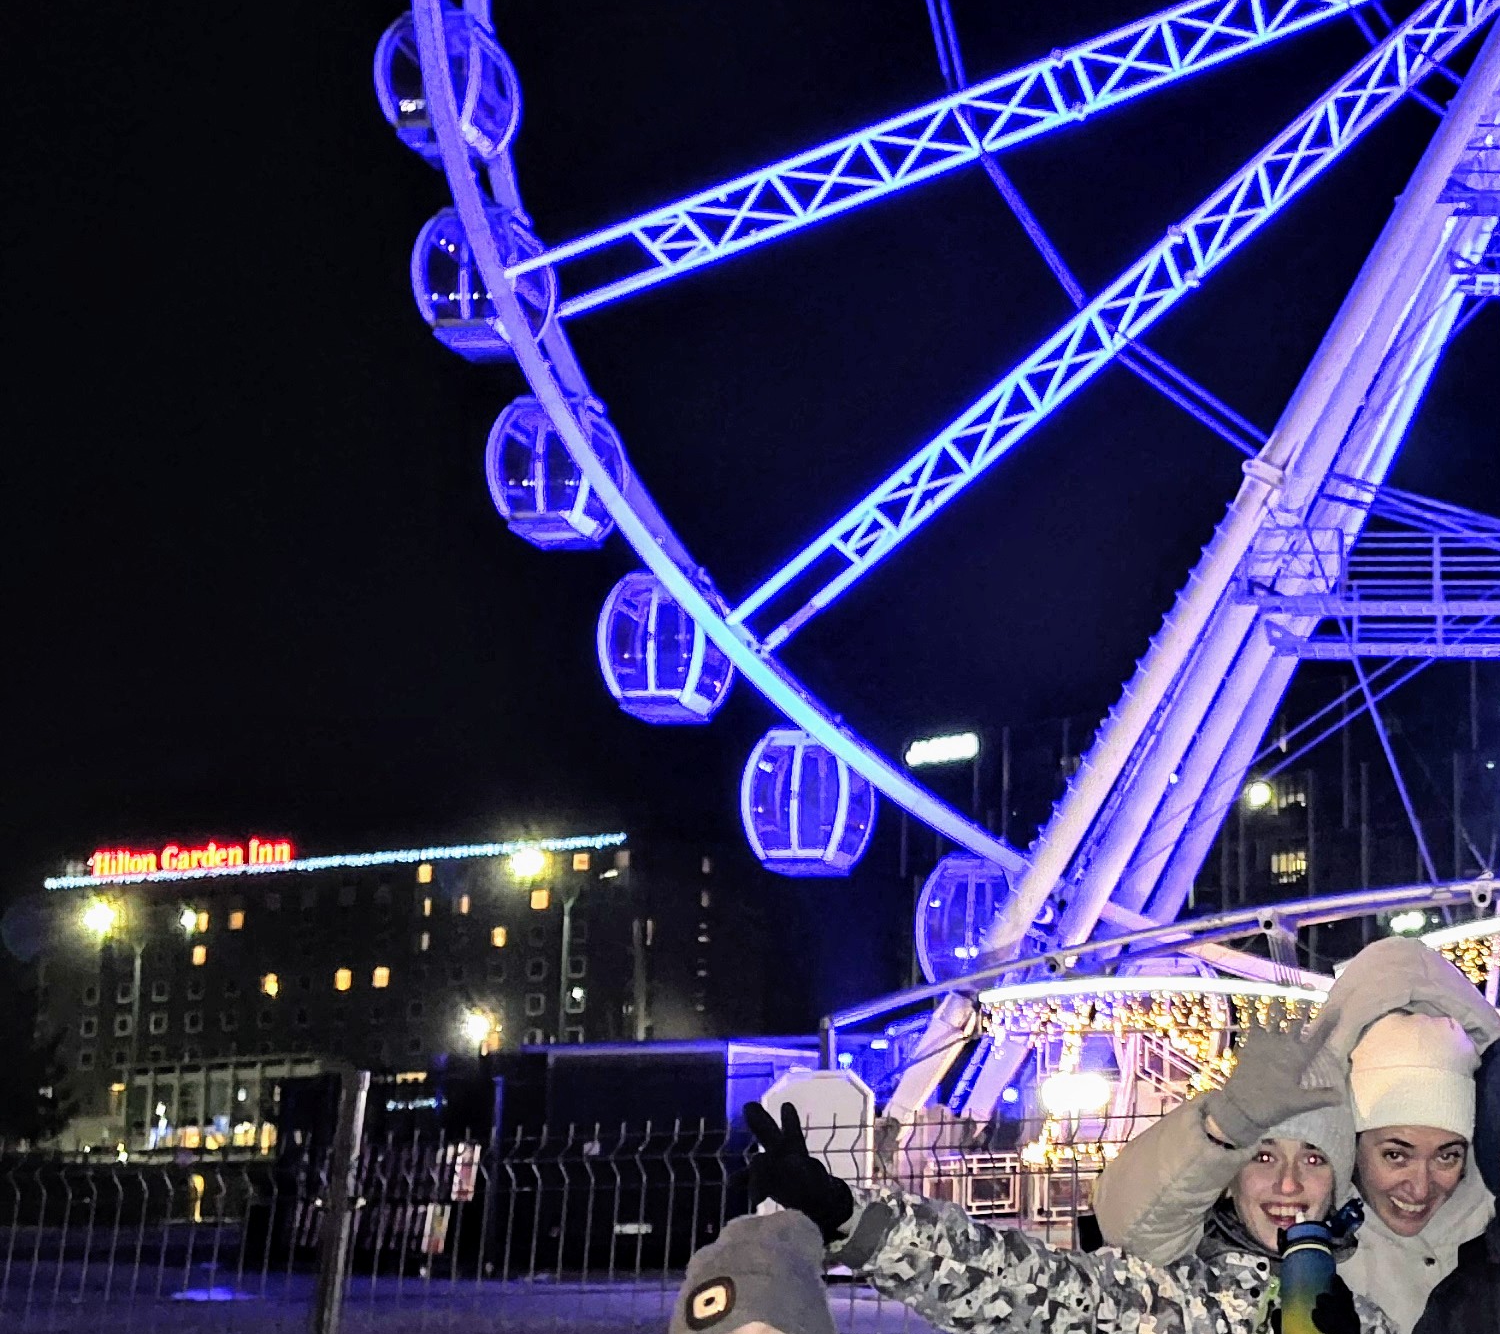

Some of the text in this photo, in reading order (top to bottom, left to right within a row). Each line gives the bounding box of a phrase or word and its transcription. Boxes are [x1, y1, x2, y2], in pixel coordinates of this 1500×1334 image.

[93, 839, 291, 876] Hilton Garden Inn
